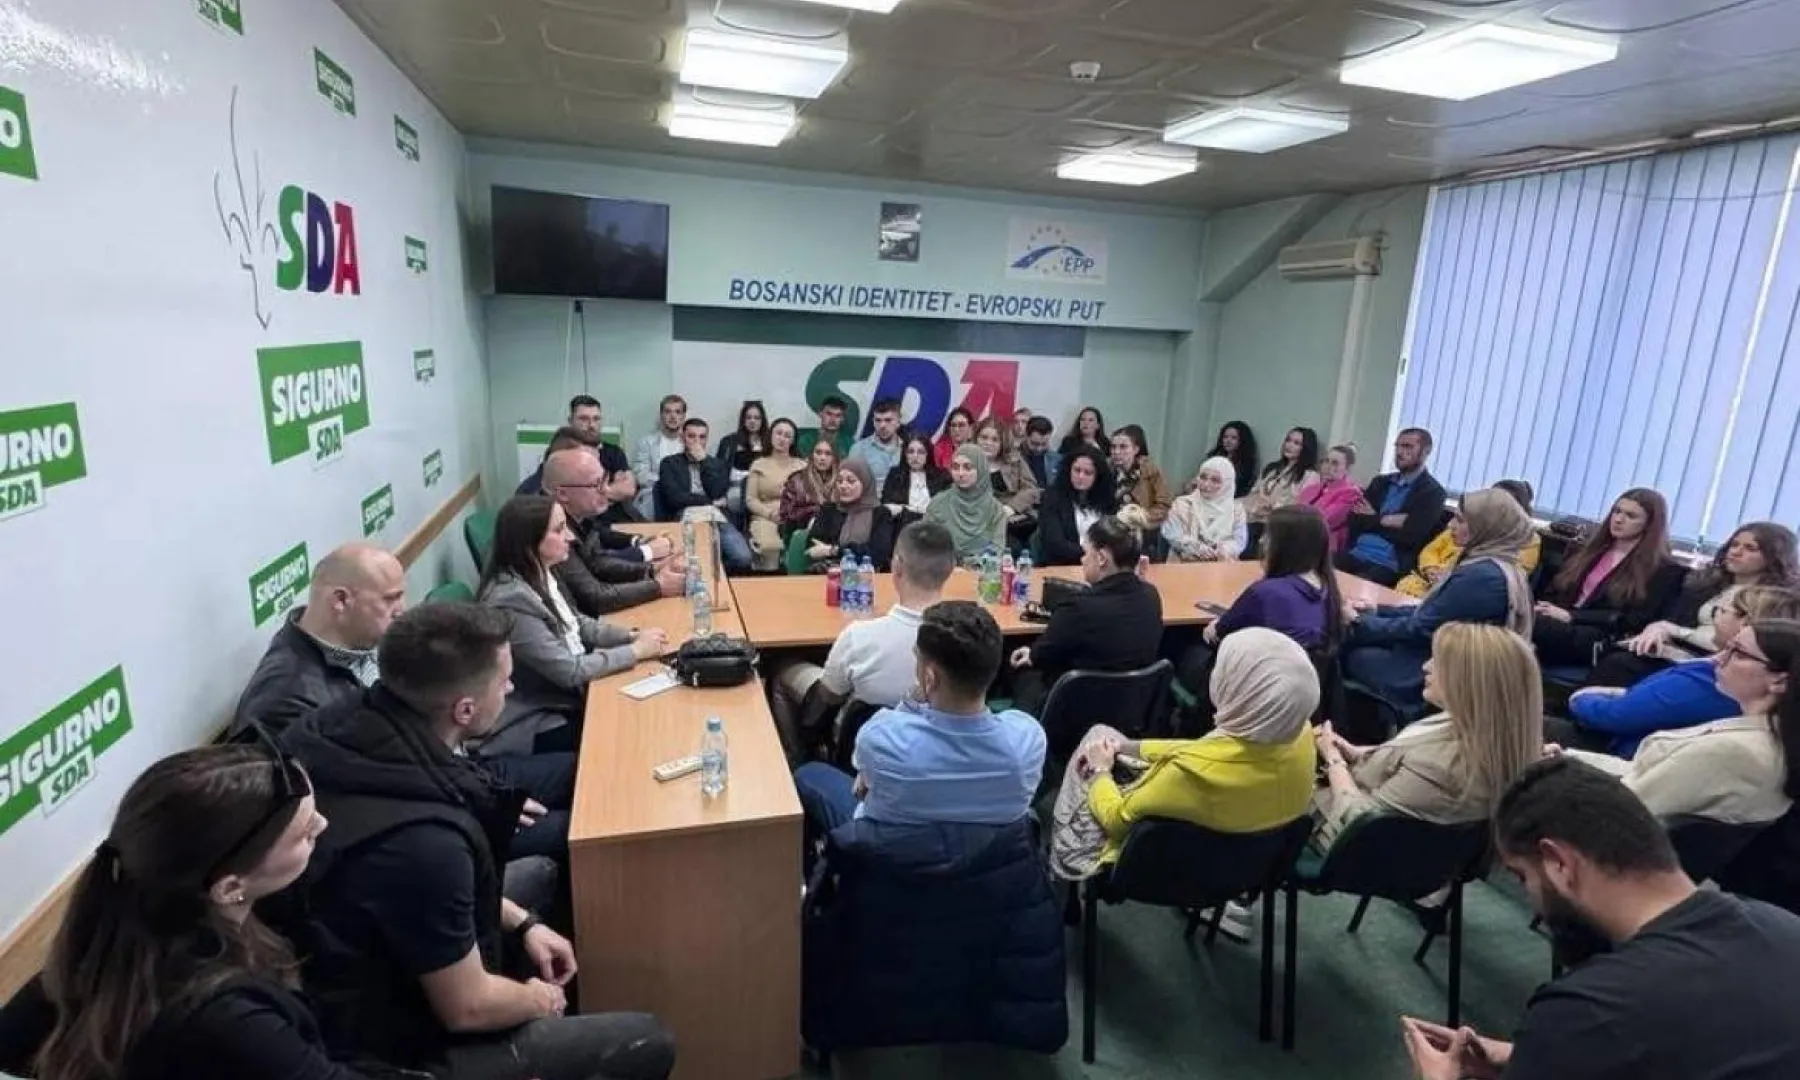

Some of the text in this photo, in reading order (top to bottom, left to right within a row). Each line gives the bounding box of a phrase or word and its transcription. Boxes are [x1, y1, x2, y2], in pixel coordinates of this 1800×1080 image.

[277, 185, 361, 295] SDA
[1064, 256, 1094, 273] EPP
[729, 278, 844, 306] BOSANSKI
[849, 286, 952, 313] IDENTITET
[966, 293, 1062, 318] EVROPSKI
[1068, 300, 1106, 320] PUT
[272, 363, 361, 427] SIGURNO
[805, 355, 1019, 441] SDA
[317, 423, 342, 461] SDA
[0, 687, 121, 806] SIGURNO
[51, 755, 89, 805] SDA
